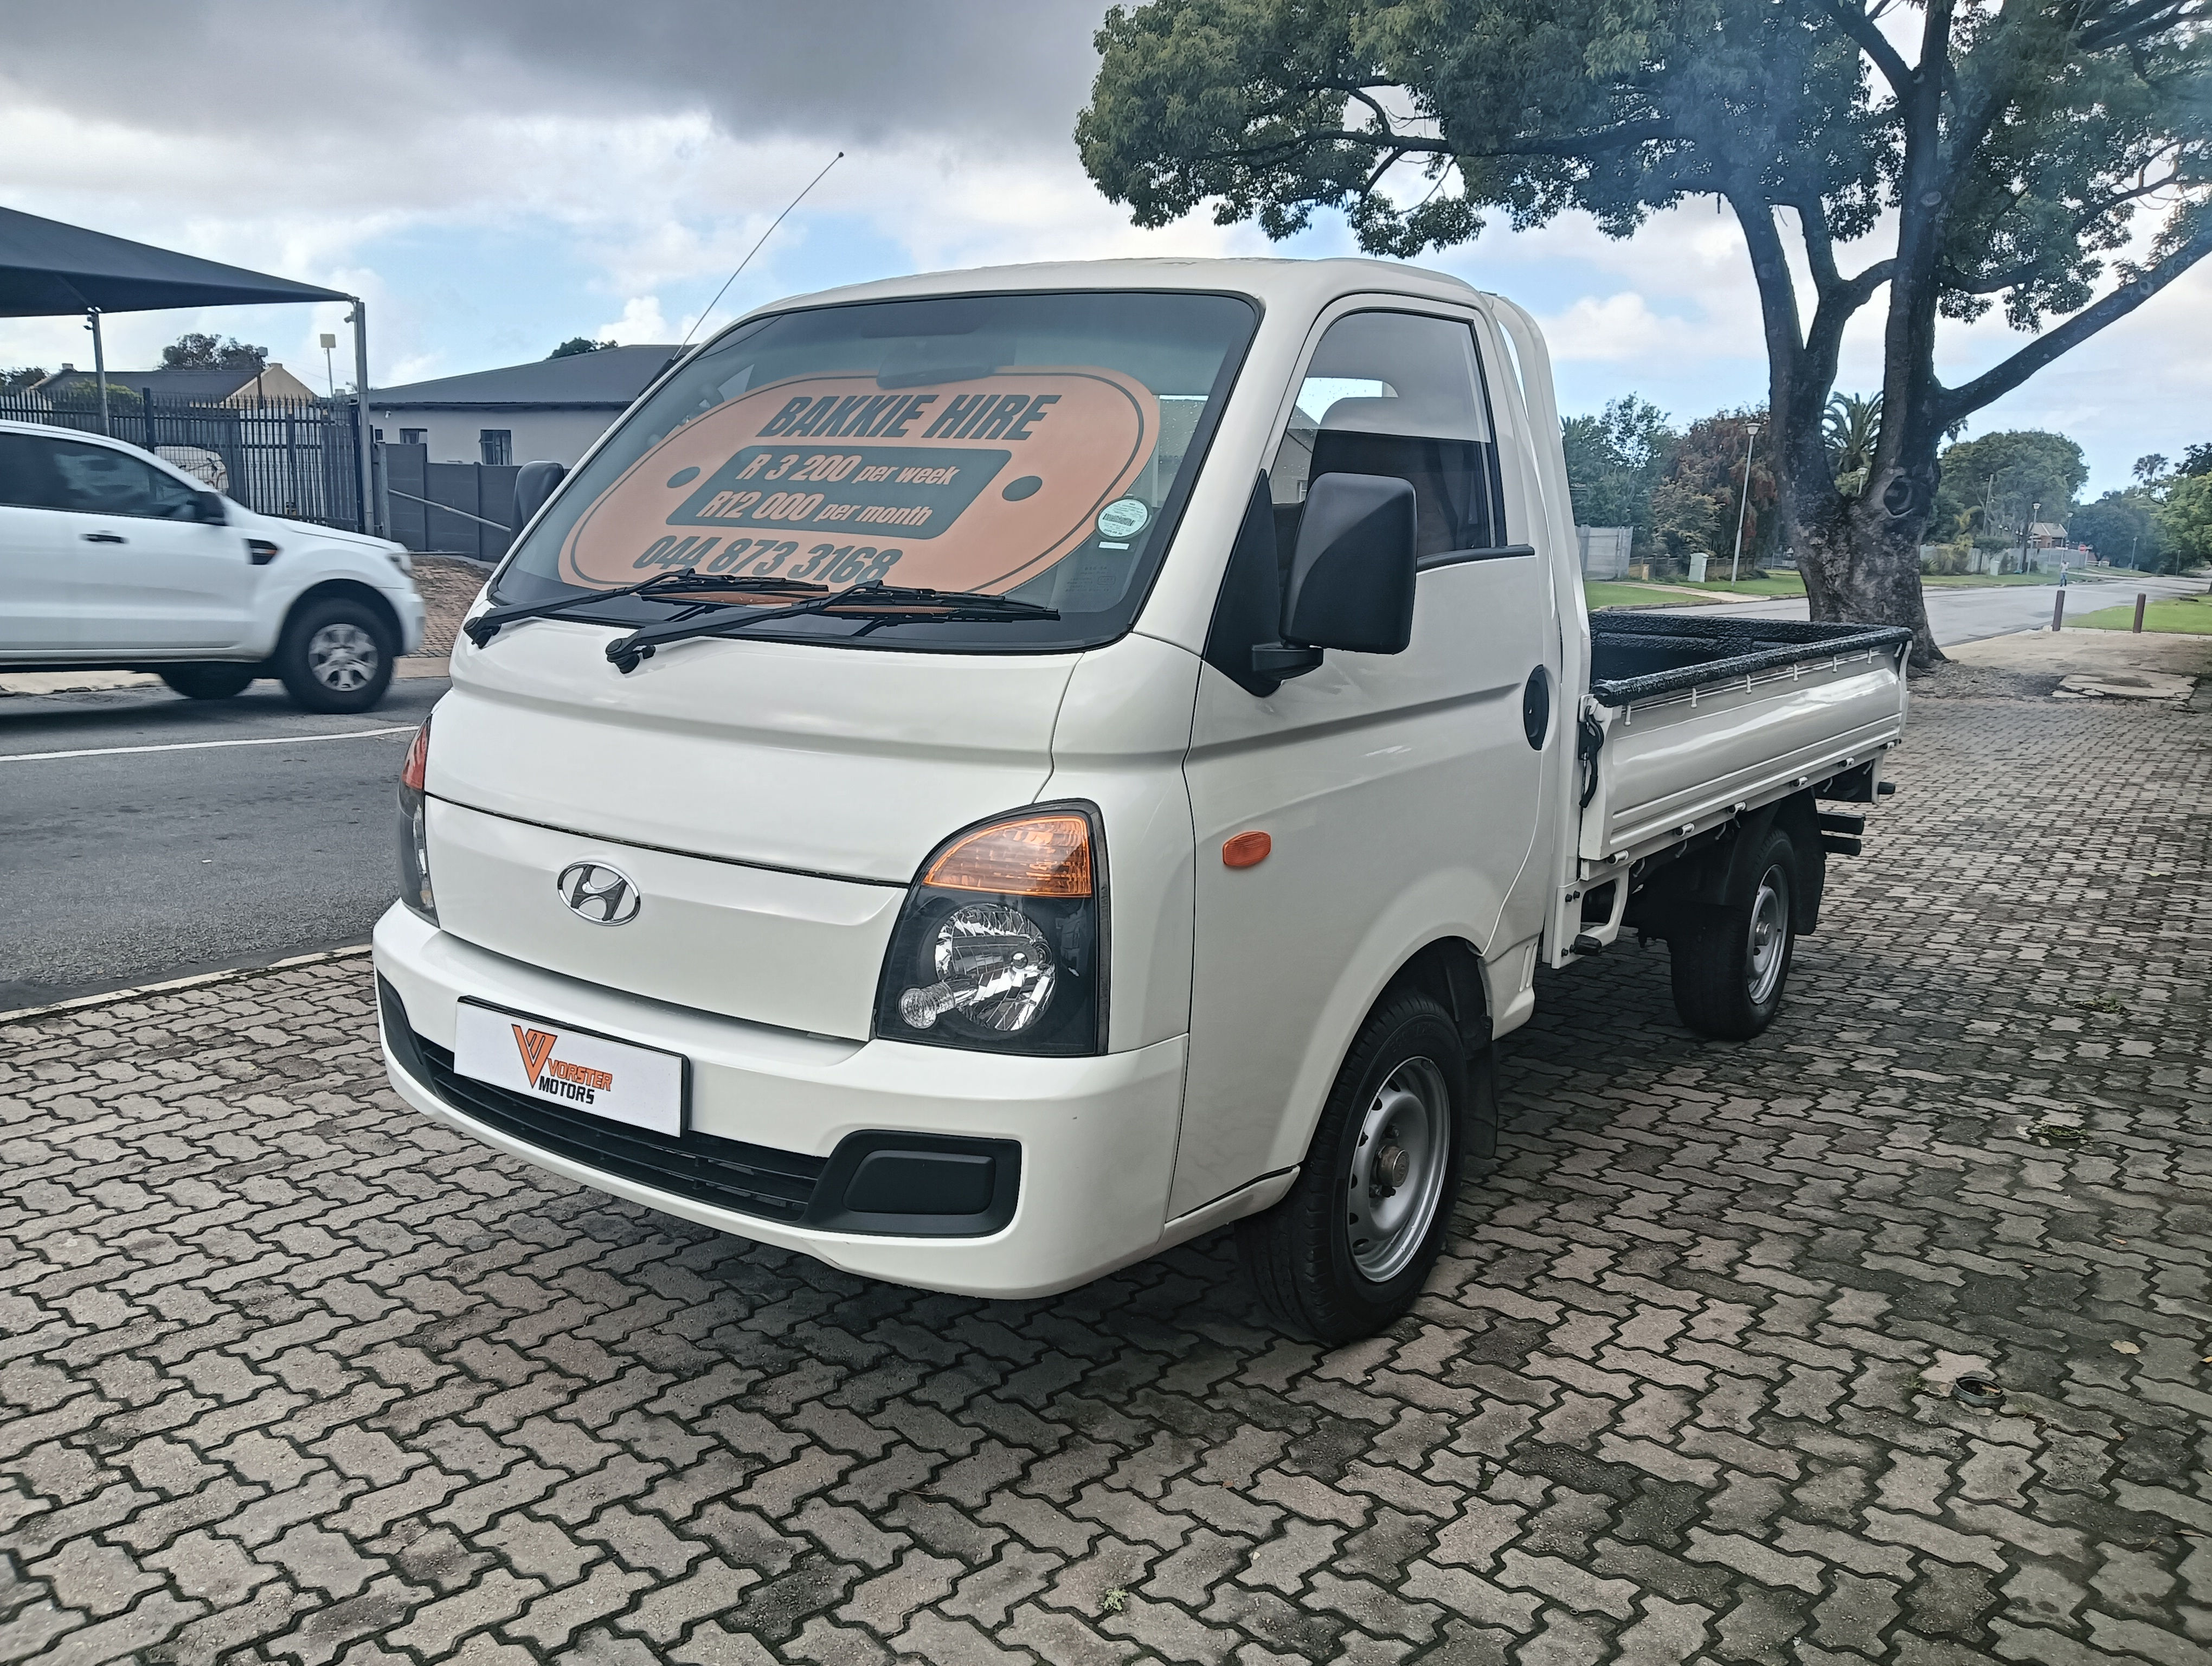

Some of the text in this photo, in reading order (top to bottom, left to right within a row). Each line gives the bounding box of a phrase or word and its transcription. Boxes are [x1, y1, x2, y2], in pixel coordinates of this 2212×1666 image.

[756, 395, 1063, 440] BAKKIE HIRE
[736, 453, 961, 485] R 3 200 per week
[696, 491, 933, 526] R12 000 per month
[632, 535, 903, 585] 044 873 3168
[538, 1075, 595, 1105] MOTORS
[547, 1058, 613, 1092] VORSTER
